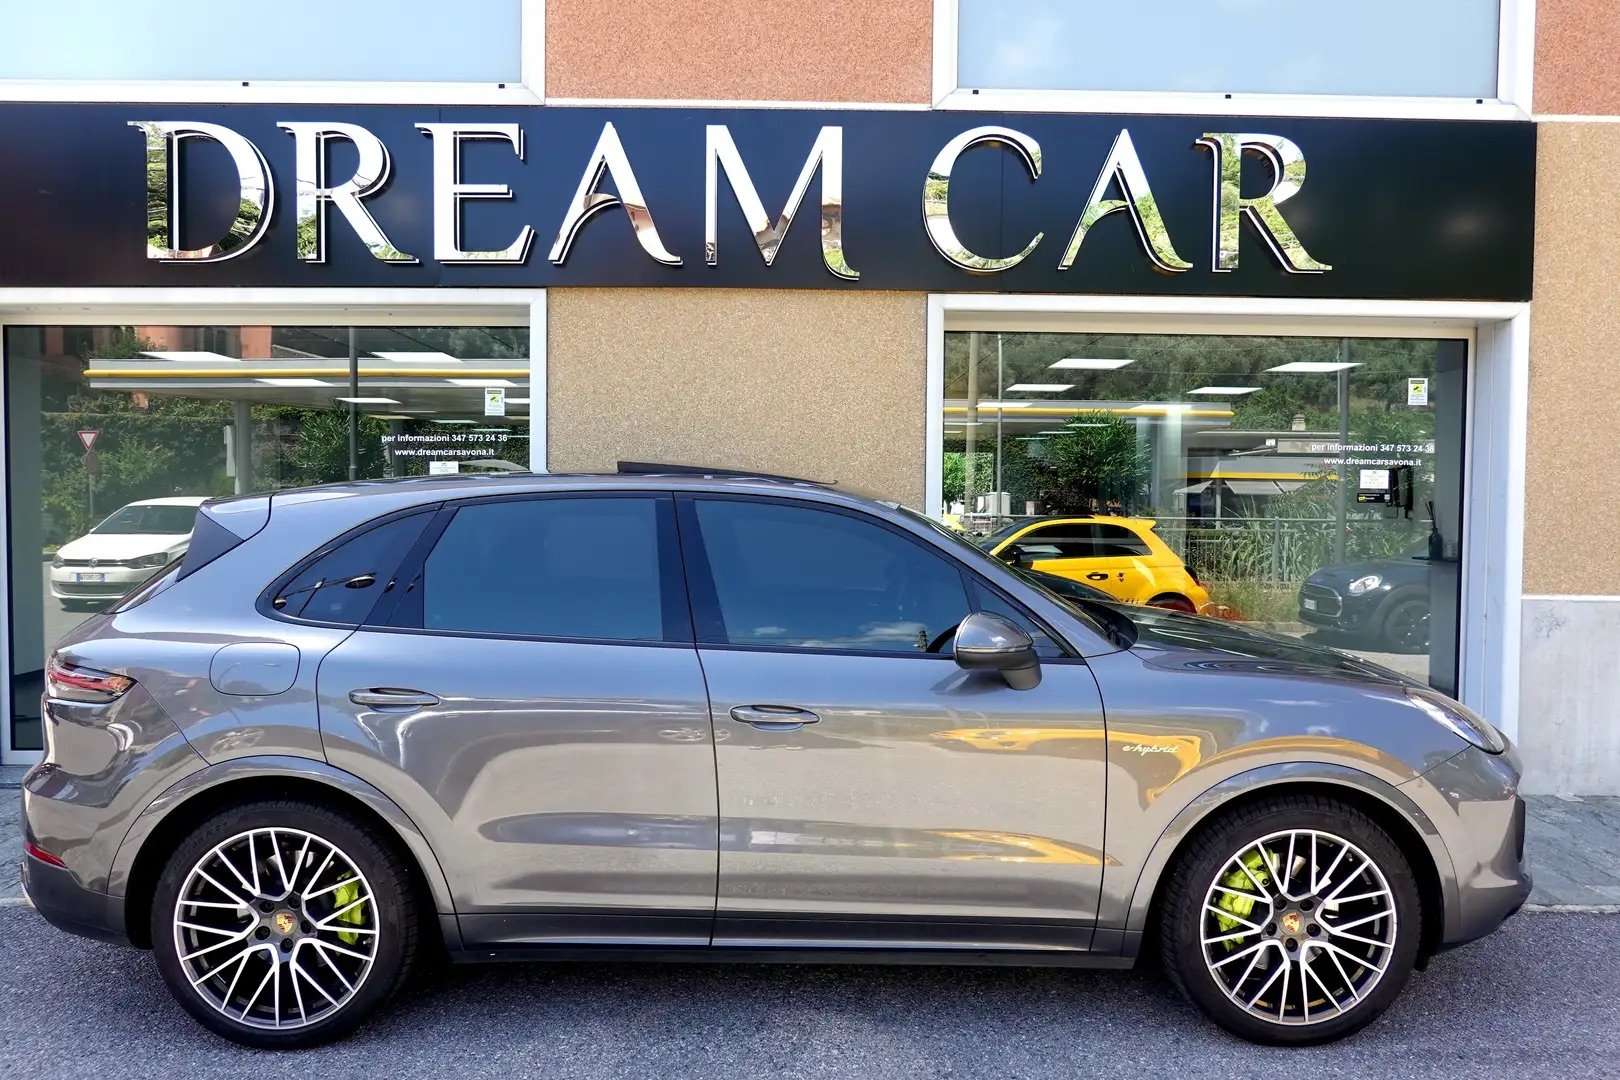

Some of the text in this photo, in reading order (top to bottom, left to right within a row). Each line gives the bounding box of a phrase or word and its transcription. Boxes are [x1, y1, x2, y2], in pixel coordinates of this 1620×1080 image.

[127, 121, 1333, 281] DREAM CAR
[381, 434, 508, 444] per informazioni 347 573 24 36
[394, 448, 495, 456] www.dreamcarsavona.it
[1311, 444, 1325, 453] per
[1327, 443, 1378, 452] informazioni
[1380, 444, 1394, 452] 347
[1323, 457, 1422, 466] www.dreamcarsavona.it
